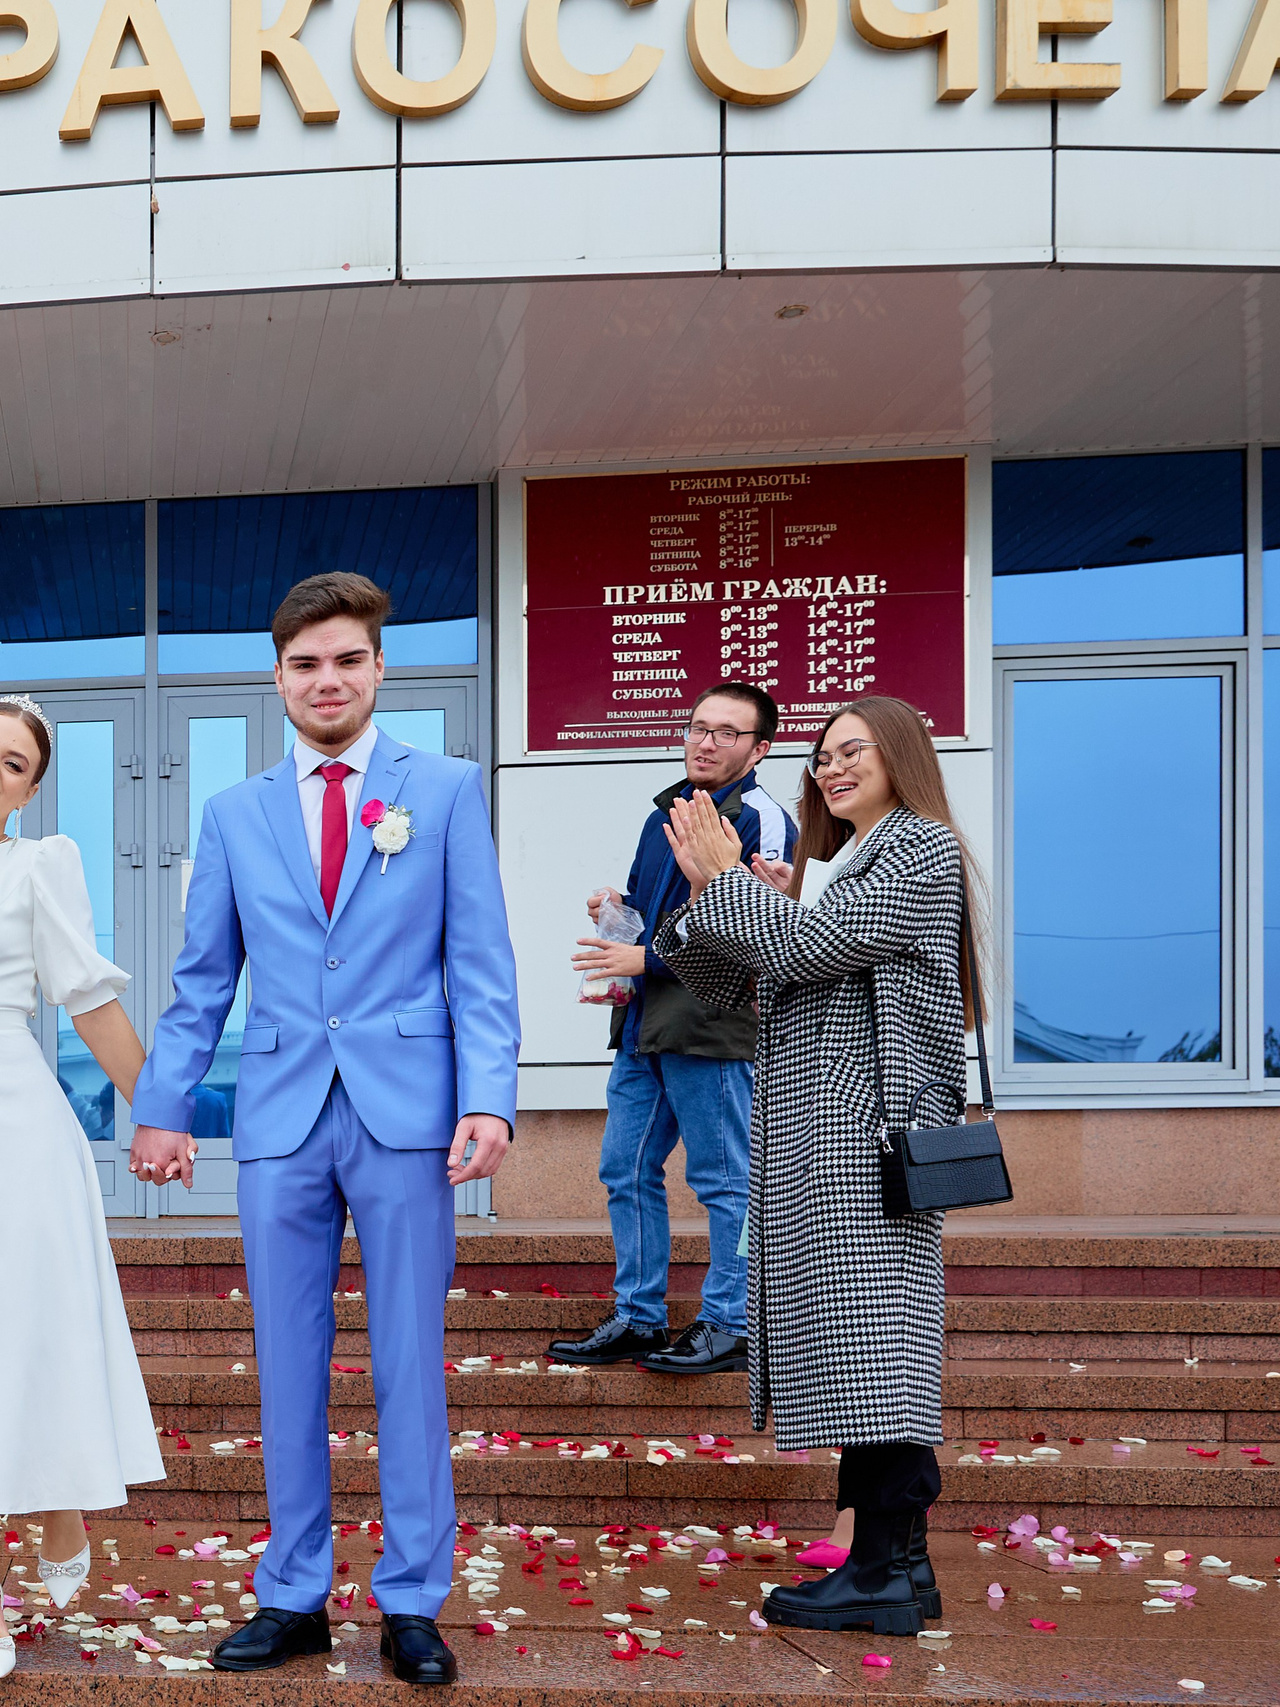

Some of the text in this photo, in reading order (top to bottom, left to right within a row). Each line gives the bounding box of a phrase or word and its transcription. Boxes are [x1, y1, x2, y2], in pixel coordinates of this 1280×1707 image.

[669, 473, 811, 491] РЕЖИМ РАБОТЫ:
[687, 491, 793, 506] РАБОЧИЙ ДЕНЬ:
[650, 513, 700, 523] ВТОРНИК
[649, 527, 684, 536] СРЕДА
[784, 524, 837, 533] ПЕРЕРЫВ
[650, 538, 697, 548] ЧЕТВЕРГ
[650, 550, 701, 560] ПЯТНИЦА
[650, 563, 698, 573] СУББОТА
[603, 575, 887, 606] ПРИЁМ ГРАЖДАН:
[612, 612, 686, 627] ВТОРНИК
[612, 632, 662, 646] СРЕДА
[612, 650, 681, 664] ЧЕТВЕРГ
[612, 668, 688, 683] ПЯТНИЦА
[612, 686, 682, 701] СУББОТА
[606, 710, 669, 719] ВЫХОДНЫЕ
[790, 701, 852, 713] ПОНЕДЕЛ
[557, 729, 671, 740] ПРОФИЛАКТИЧЕСКИЙ
[788, 722, 825, 732] РАБОЧ
